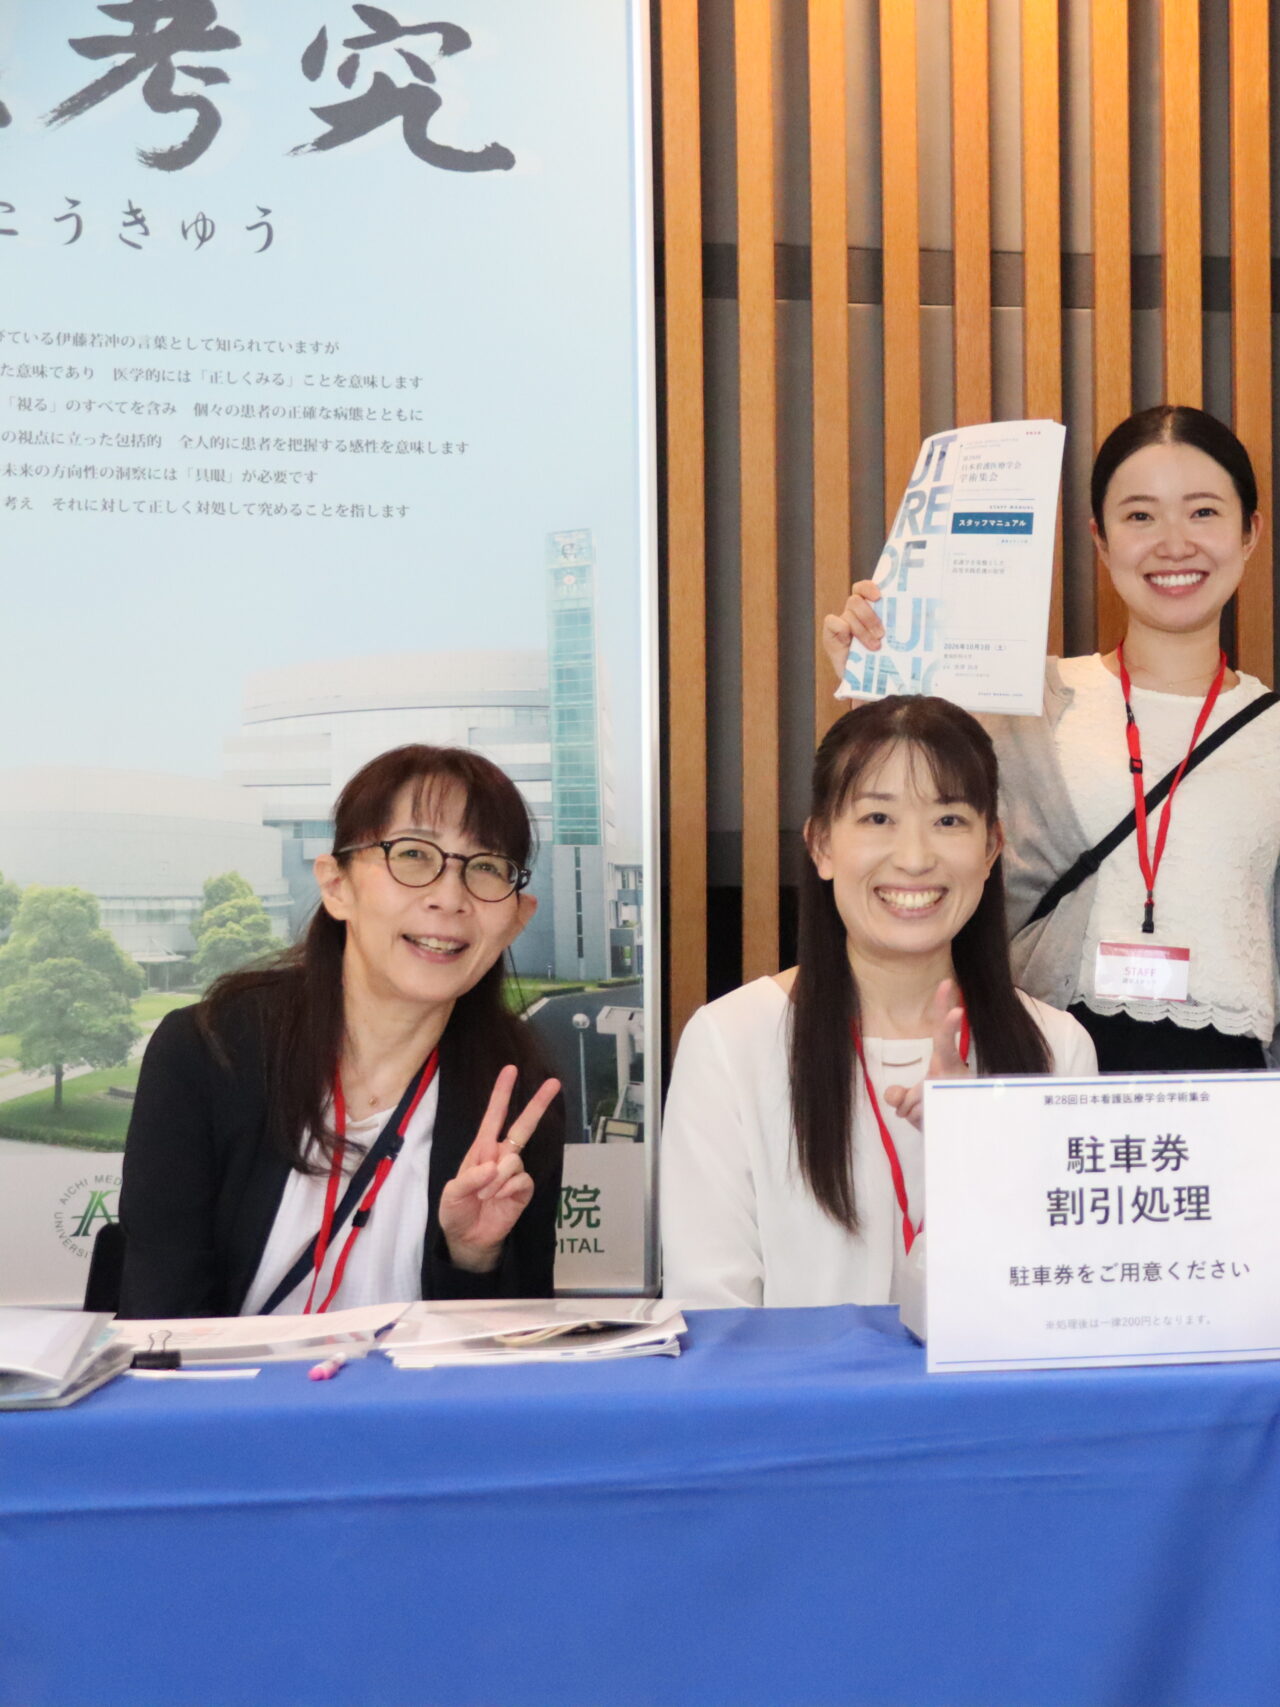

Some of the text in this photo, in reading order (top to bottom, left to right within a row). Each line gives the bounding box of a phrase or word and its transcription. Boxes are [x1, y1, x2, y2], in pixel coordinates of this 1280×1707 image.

[0, 0, 516, 172] 考究
[958, 518, 1027, 528] スタッフマニュアル
[1044, 1091, 1210, 1106] 第28回日本看護医療学会学術集会
[1066, 1132, 1190, 1175] 駐車券
[1046, 1184, 1213, 1227] 割引処理
[1008, 1259, 1251, 1287] 駐車券をご用意ください
